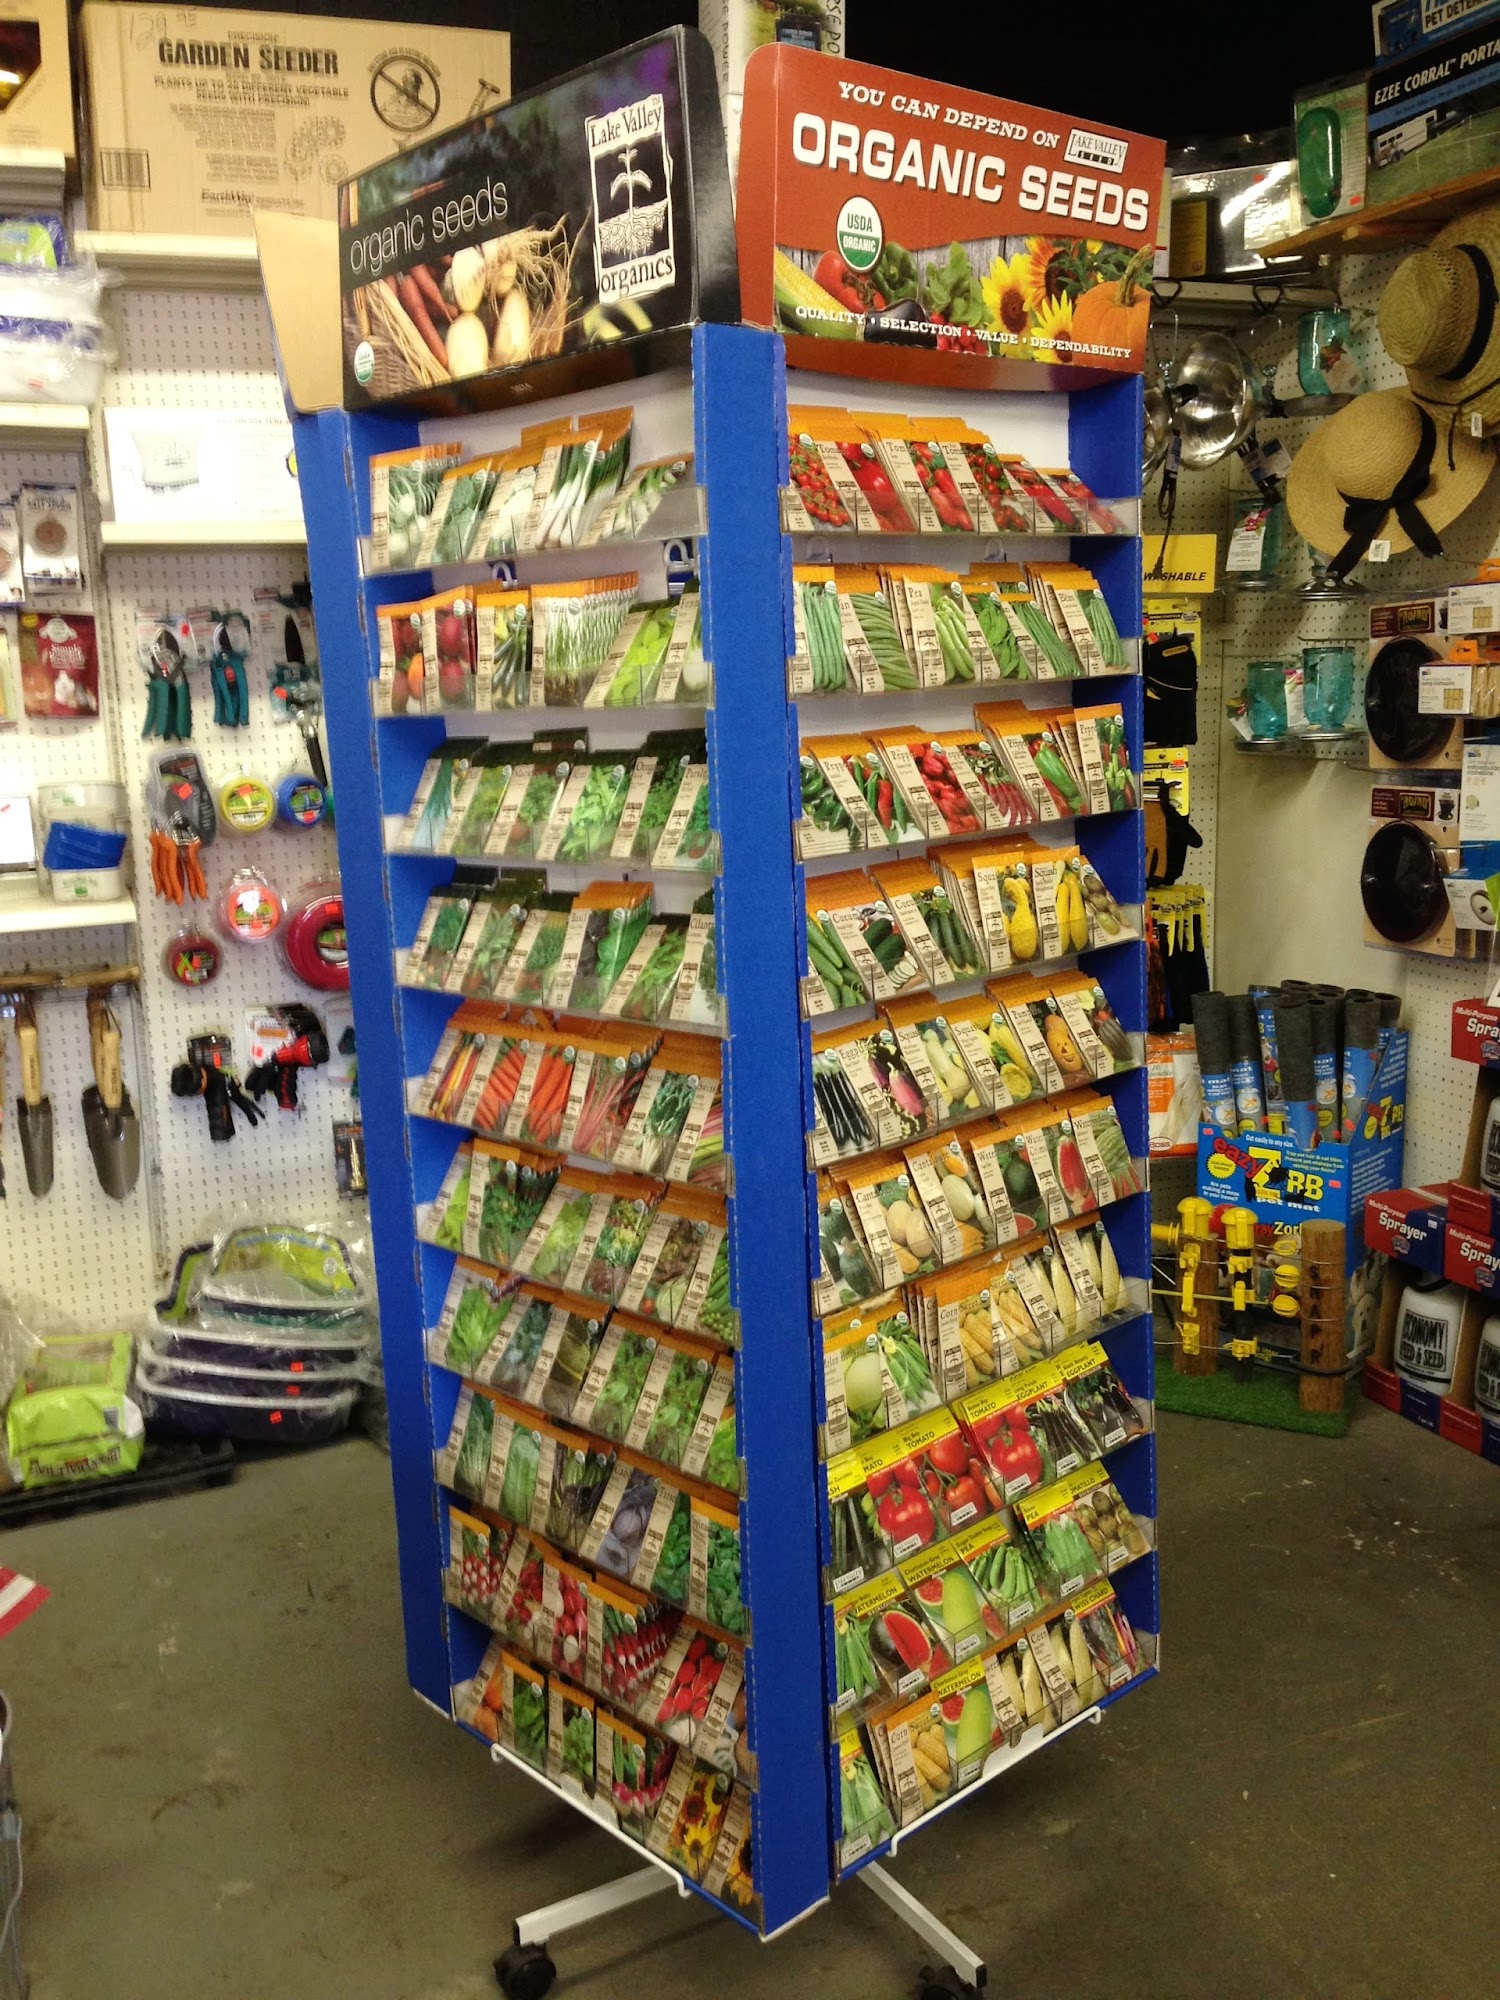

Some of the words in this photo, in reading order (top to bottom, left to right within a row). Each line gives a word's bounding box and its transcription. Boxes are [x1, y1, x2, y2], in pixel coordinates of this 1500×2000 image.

[158, 37, 250, 69] GARDEN
[259, 44, 339, 75] SEEDER
[1375, 82, 1401, 106] EZEE
[838, 80, 886, 107] YOU
[891, 93, 940, 121] CAN
[944, 104, 1028, 143] DEPEND
[1032, 129, 1061, 150] ON
[590, 118, 622, 149] Lake
[621, 104, 663, 137] Valley
[1068, 134, 1094, 156] LAKE
[1093, 138, 1127, 167] VALLEY
[1078, 150, 1115, 166] SEED
[792, 111, 1006, 204] ORGANIC
[1018, 164, 1151, 232] SEEDS
[349, 211, 426, 279] organic
[431, 177, 510, 248] seeds
[846, 214, 873, 234] USDA
[842, 234, 877, 254] ORGANIC
[600, 253, 674, 298] organics
[794, 304, 867, 326] QUALITY
[879, 316, 963, 338] SELECTION
[974, 329, 1020, 345] VALUE
[1030, 336, 1132, 360] DEPENDABILITY
[1143, 570, 1207, 583] WASHABLE
[907, 585, 923, 598] Pea
[686, 767, 708, 780] Parsle
[1034, 867, 1058, 881] Squash
[690, 918, 715, 930] Cilantr
[1455, 1005, 1499, 1022] Multi-Purpose
[1246, 1133, 1255, 1143] Cut
[1213, 1137, 1264, 1180] eazy
[1287, 1201, 1321, 1213] mat
[1368, 1199, 1407, 1219] Multi-Purpose
[1378, 1212, 1428, 1242] Sprayer
[1448, 1228, 1492, 1250] Multi-Purpose
[940, 1308, 959, 1320] Corn
[1404, 1312, 1447, 1350] ECONOMY
[1066, 1358, 1097, 1378] EGGPLANT
[1423, 1348, 1445, 1369] SEED
[714, 1370, 735, 1387] Lettu
[1016, 1381, 1049, 1401] EGGPLANT
[969, 1401, 997, 1419] TOMATO
[902, 1435, 911, 1443] Big
[907, 1430, 936, 1450] TOMATO
[863, 1458, 884, 1473] MATO
[1070, 1477, 1096, 1494] OMATILLO
[1026, 1510, 1040, 1521] PEA
[961, 1543, 975, 1555] PEA
[908, 1555, 955, 1584] WATERMELON
[1030, 1630, 1048, 1644] Corn
[890, 1729, 908, 1745] Corn
